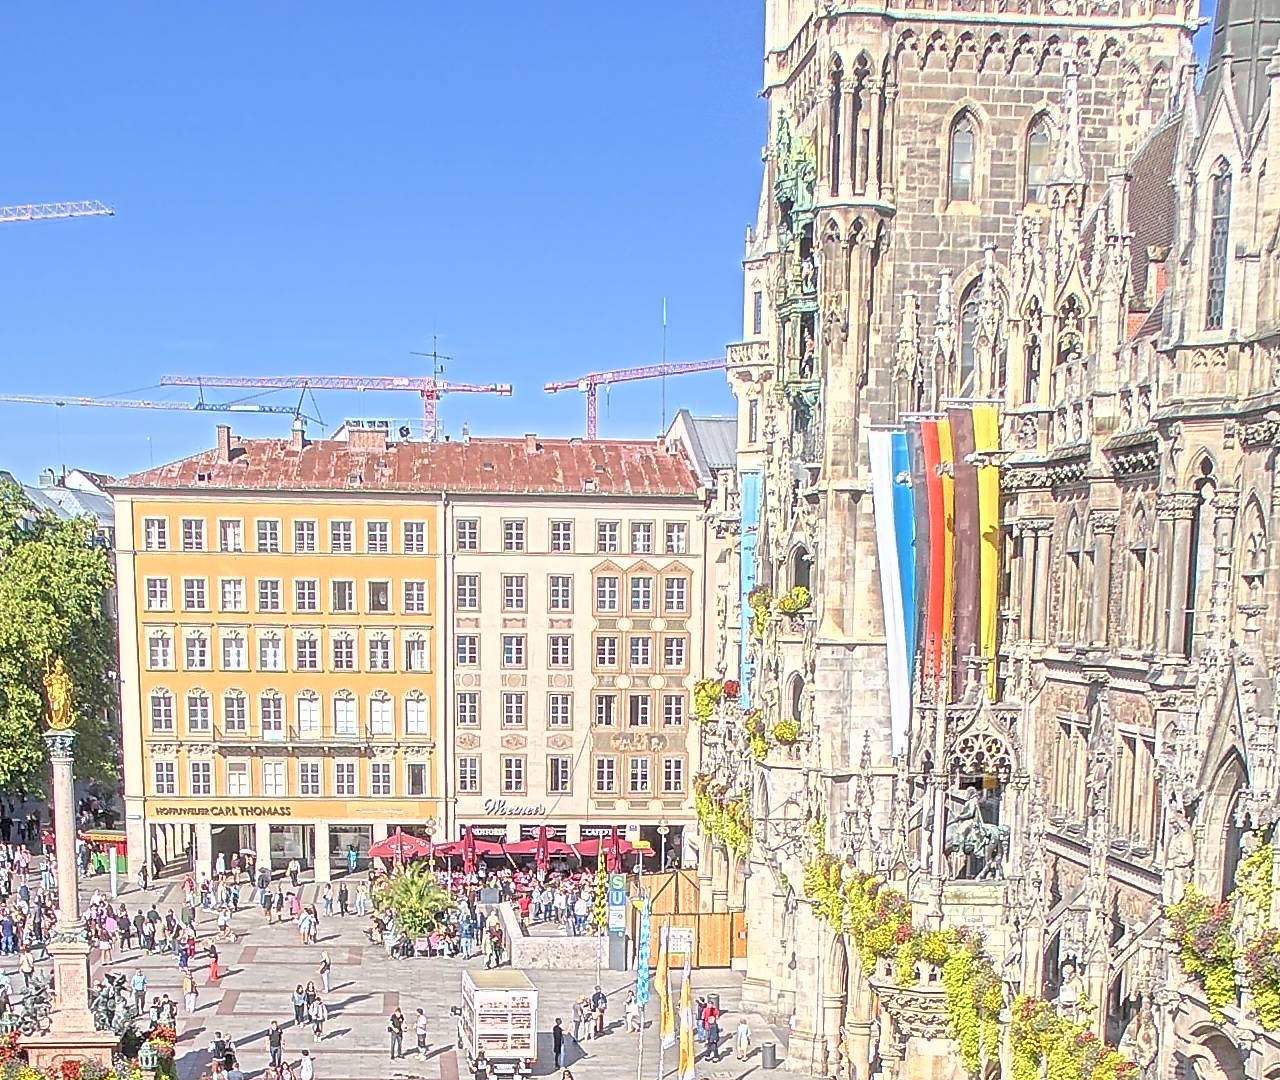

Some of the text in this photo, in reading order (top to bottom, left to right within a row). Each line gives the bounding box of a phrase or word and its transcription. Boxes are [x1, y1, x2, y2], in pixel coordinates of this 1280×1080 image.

[210, 806, 238, 817] CARL
[239, 806, 291, 817] THOMASS
[611, 875, 624, 890] S
[612, 891, 623, 905] U
